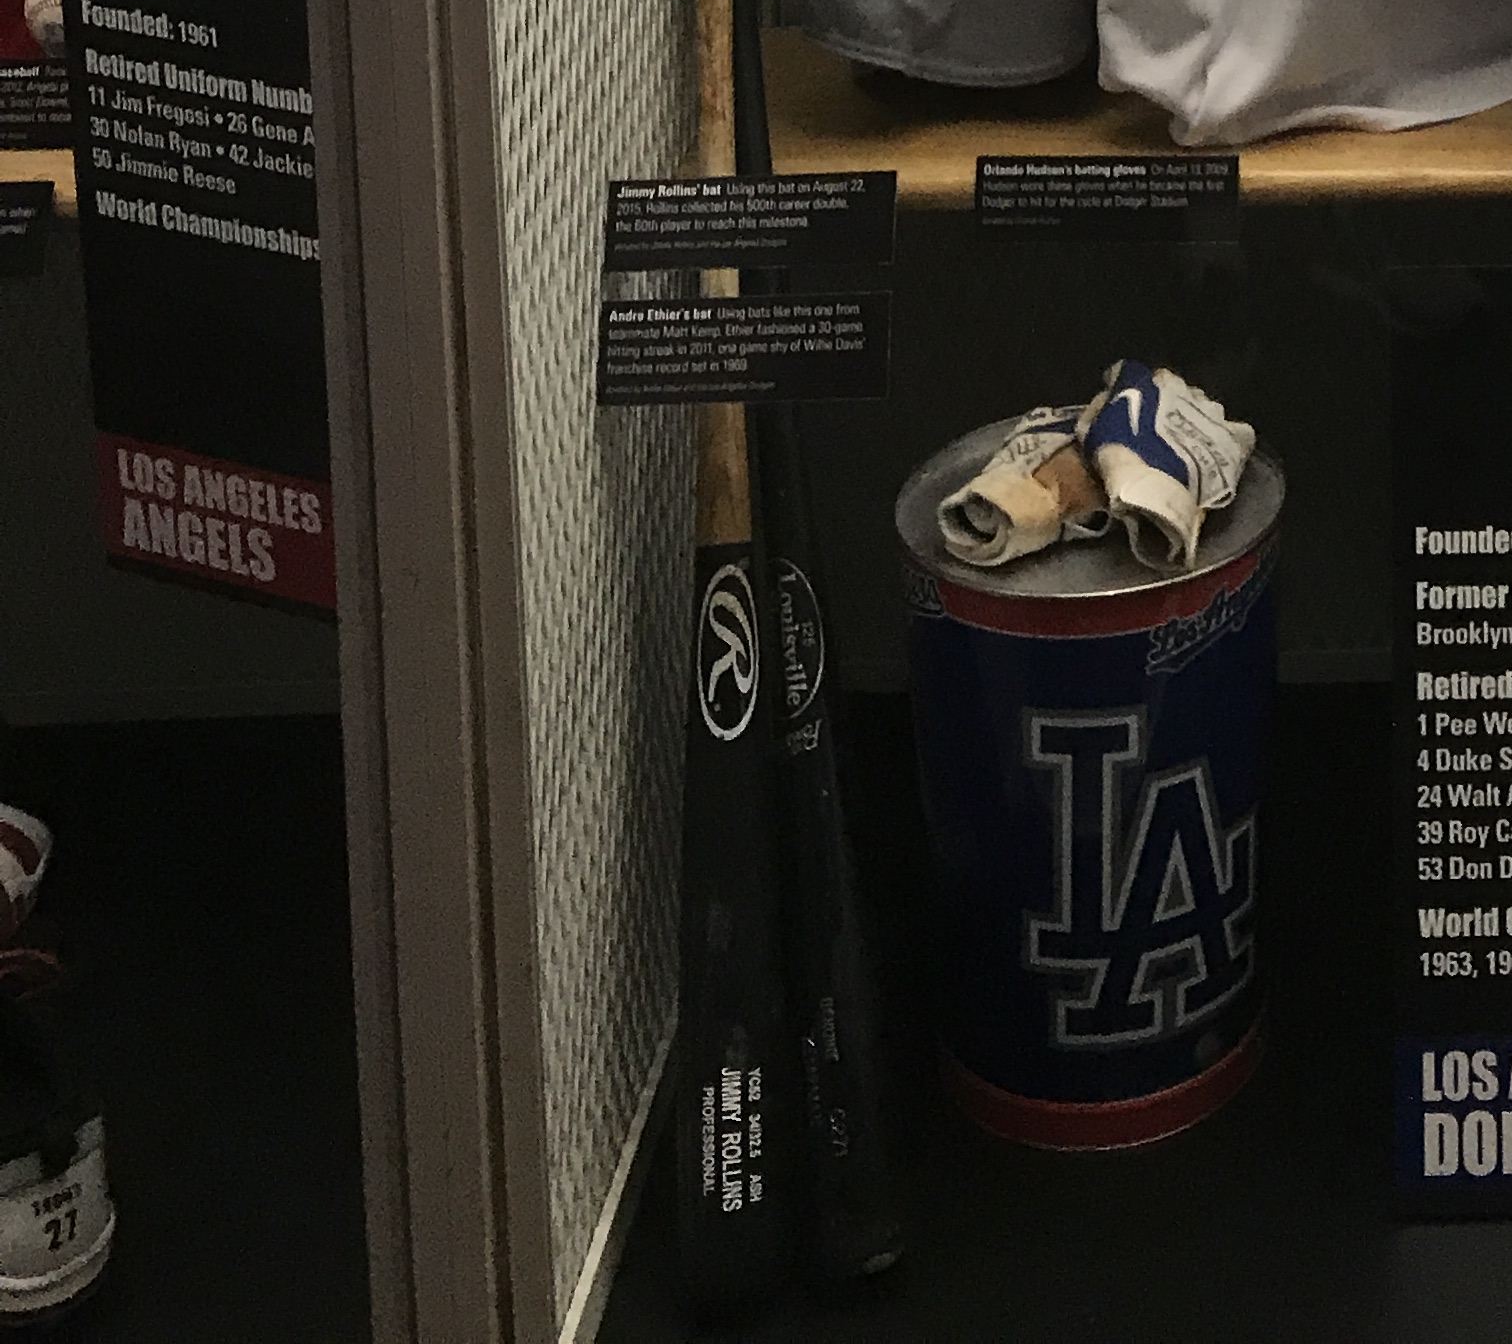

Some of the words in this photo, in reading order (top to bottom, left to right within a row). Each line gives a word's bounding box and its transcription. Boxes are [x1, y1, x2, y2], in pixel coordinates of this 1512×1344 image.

[82, 0, 174, 40] Founded:
[178, 21, 218, 48] 1961
[85, 48, 160, 86] Retired
[164, 63, 246, 102] Uniform
[252, 80, 312, 114] Numb
[89, 86, 105, 105] 11
[111, 90, 142, 114] Jim
[147, 96, 209, 127] Fregosi
[227, 112, 247, 134] 26
[252, 117, 297, 144] Gene
[90, 117, 109, 138] 30
[113, 120, 164, 149] Nolan
[169, 131, 212, 158] Ryan
[229, 144, 249, 165] 42
[253, 148, 313, 178] Jackie
[93, 147, 111, 169] 50
[116, 153, 178, 182] Jimmie
[184, 165, 236, 194] Reese
[97, 191, 157, 226] World
[617, 187, 655, 199] Jimmy
[703, 184, 720, 195] bat
[117, 449, 177, 500] LOS
[184, 465, 322, 534] ANGELES
[123, 496, 277, 582] ANGELS
[1417, 582, 1509, 609] Former
[1417, 671, 1512, 700] Retired
[1418, 714, 1426, 735] 1
[1436, 713, 1476, 735] Pee
[1418, 750, 1429, 771] 4
[1436, 748, 1492, 771] Duke
[1418, 785, 1442, 807] 24
[1448, 784, 1500, 807] Walt
[1418, 821, 1443, 844] 39
[1449, 820, 1489, 848] Roy
[1023, 708, 1256, 1049] LA
[1419, 858, 1442, 880] 53
[1450, 857, 1492, 879] Don
[1419, 908, 1499, 937] World
[1420, 952, 1477, 978] 1963,
[721, 1067, 742, 1122] JIMMY
[1422, 1051, 1499, 1102] LOS
[701, 1086, 716, 1197] PROFESSIONAL
[721, 1131, 742, 1212] ROLLINS
